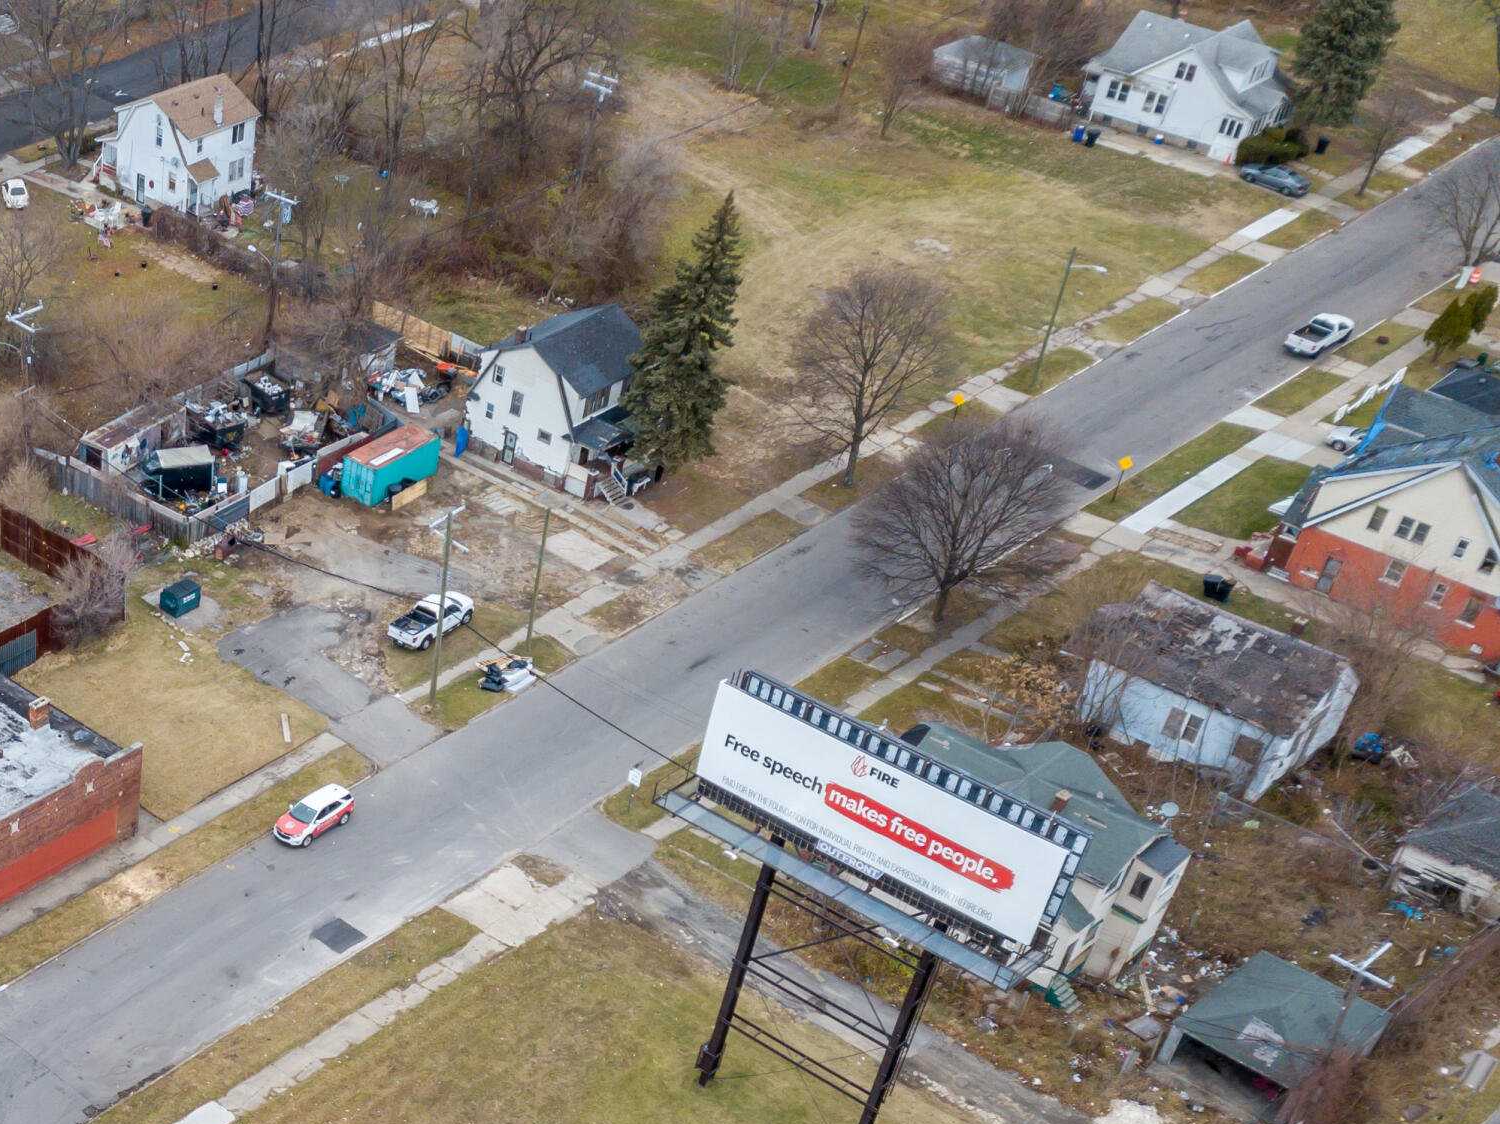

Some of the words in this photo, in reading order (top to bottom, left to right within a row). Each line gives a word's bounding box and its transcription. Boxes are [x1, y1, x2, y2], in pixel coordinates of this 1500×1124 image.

[724, 734, 760, 762] Free
[762, 755, 823, 794] speech
[828, 789, 888, 828] makes
[889, 816, 927, 847] free
[927, 839, 998, 884] people.
[869, 767, 900, 789] FIRE
[721, 775, 736, 789] PAID
[735, 782, 748, 794] FOR
[748, 787, 757, 798] BY
[757, 793, 769, 805] THE
[768, 798, 806, 825] FOUNDATION
[806, 819, 819, 832] FOR
[819, 824, 852, 849] INDIVIDUAL
[851, 840, 877, 861] RIGHTS
[875, 855, 891, 869] AND
[819, 841, 879, 878] OUTFRONT
